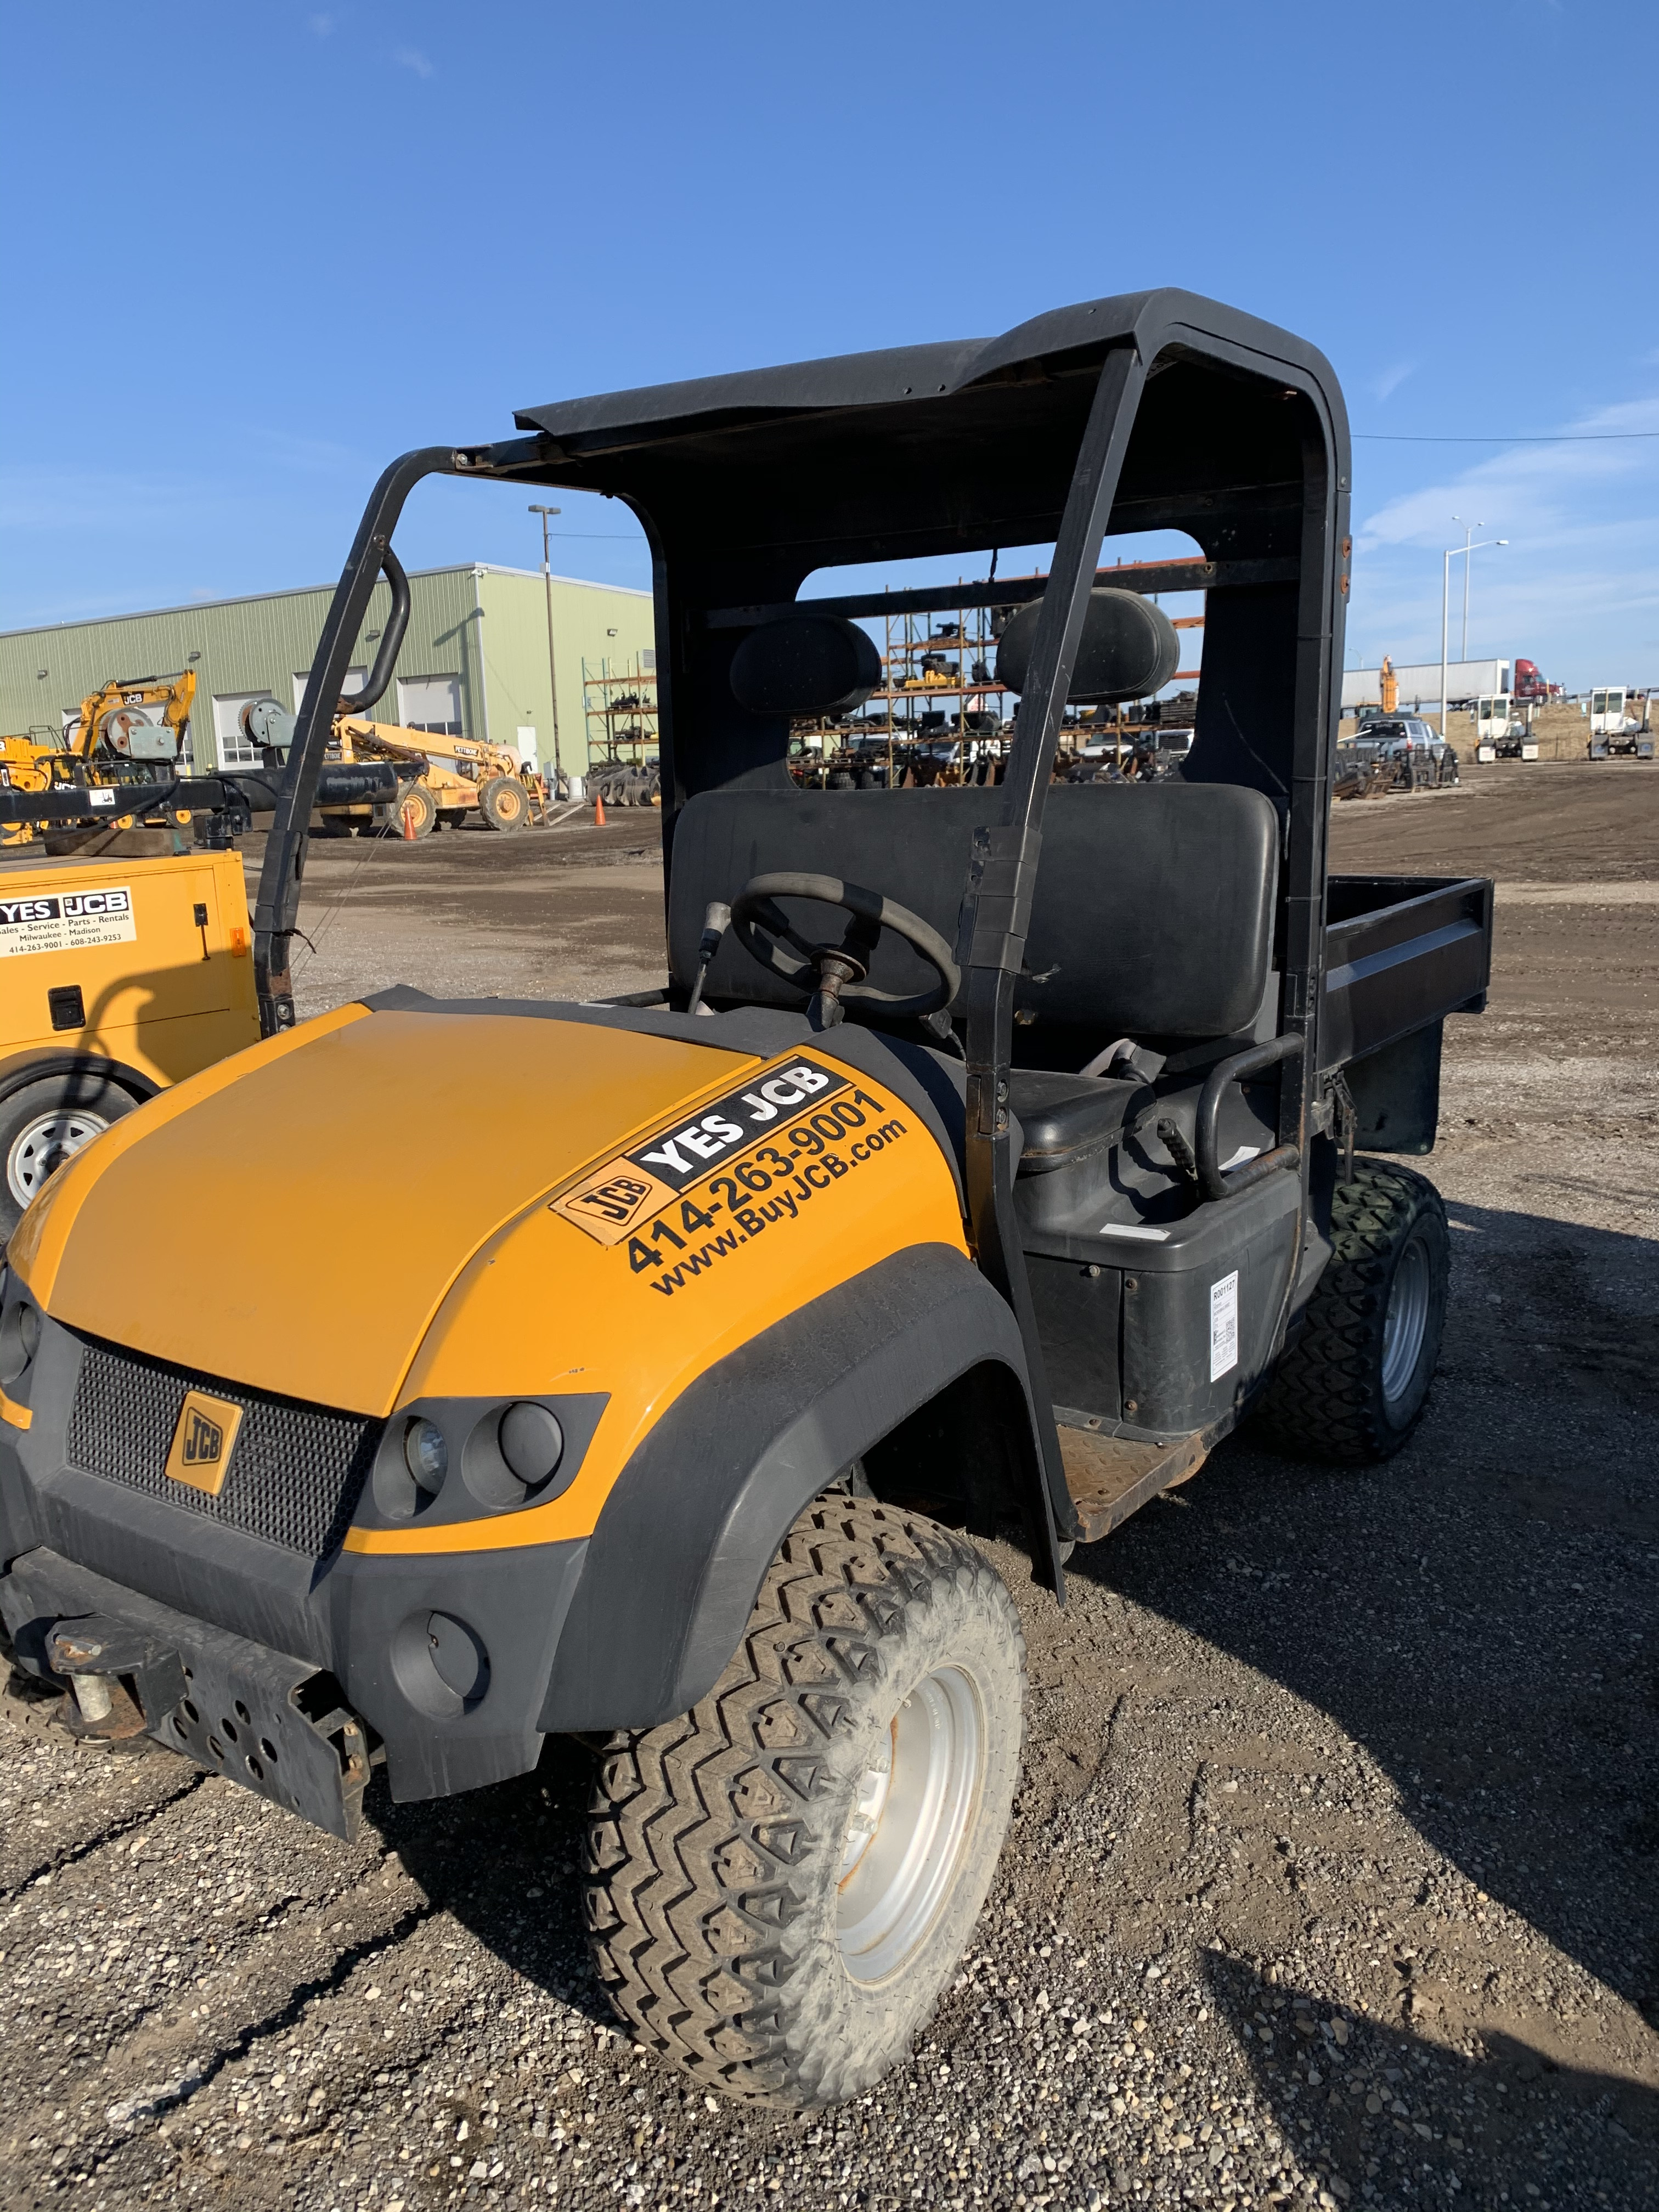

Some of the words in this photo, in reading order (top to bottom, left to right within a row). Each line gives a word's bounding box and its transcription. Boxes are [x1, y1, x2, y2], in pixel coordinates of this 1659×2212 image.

[124, 693, 143, 705] JCB
[455, 746, 477, 755] PETTIBONE
[0, 901, 51, 922] YES
[65, 893, 128, 916] JCB
[19, 932, 62, 942] Milwaukee
[69, 927, 101, 936] Madison
[27, 922, 60, 932] Service
[99, 913, 129, 923] Rentals
[9, 941, 62, 953] 414-263-9001
[70, 933, 121, 946] 608-243-9253
[640, 1115, 744, 1174] YES
[741, 1066, 830, 1121] JCB
[627, 1088, 887, 1274] 414-263-9001
[580, 1179, 647, 1220] JCB
[650, 1119, 909, 1296] www.BuyJCB.com
[1214, 1279, 1235, 1301] R001127
[185, 1415, 219, 1460] JCB
